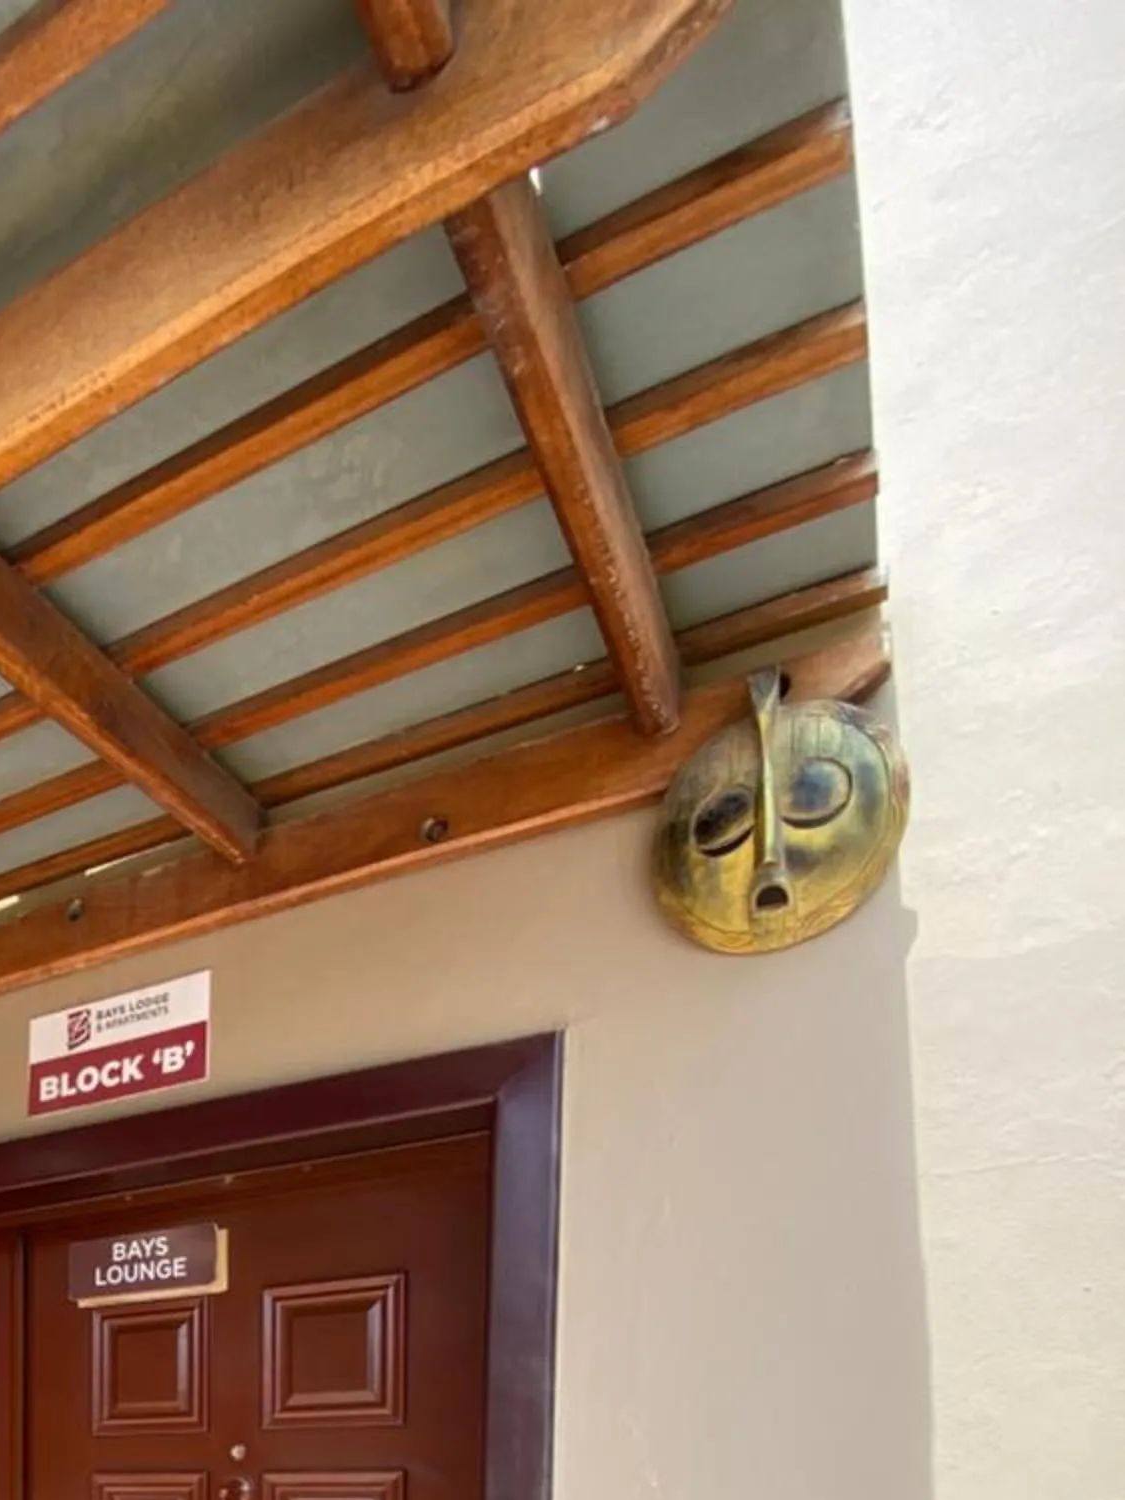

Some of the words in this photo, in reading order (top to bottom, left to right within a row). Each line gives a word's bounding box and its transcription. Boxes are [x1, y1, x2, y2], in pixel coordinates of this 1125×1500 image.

[95, 1005, 126, 1020] BAYS
[129, 992, 170, 1012] LODGE
[106, 1006, 169, 1029] APARTMENTS
[39, 1053, 145, 1102] BLOCK
[112, 1236, 169, 1262] BAYS
[95, 1256, 187, 1286] LOUNGE
